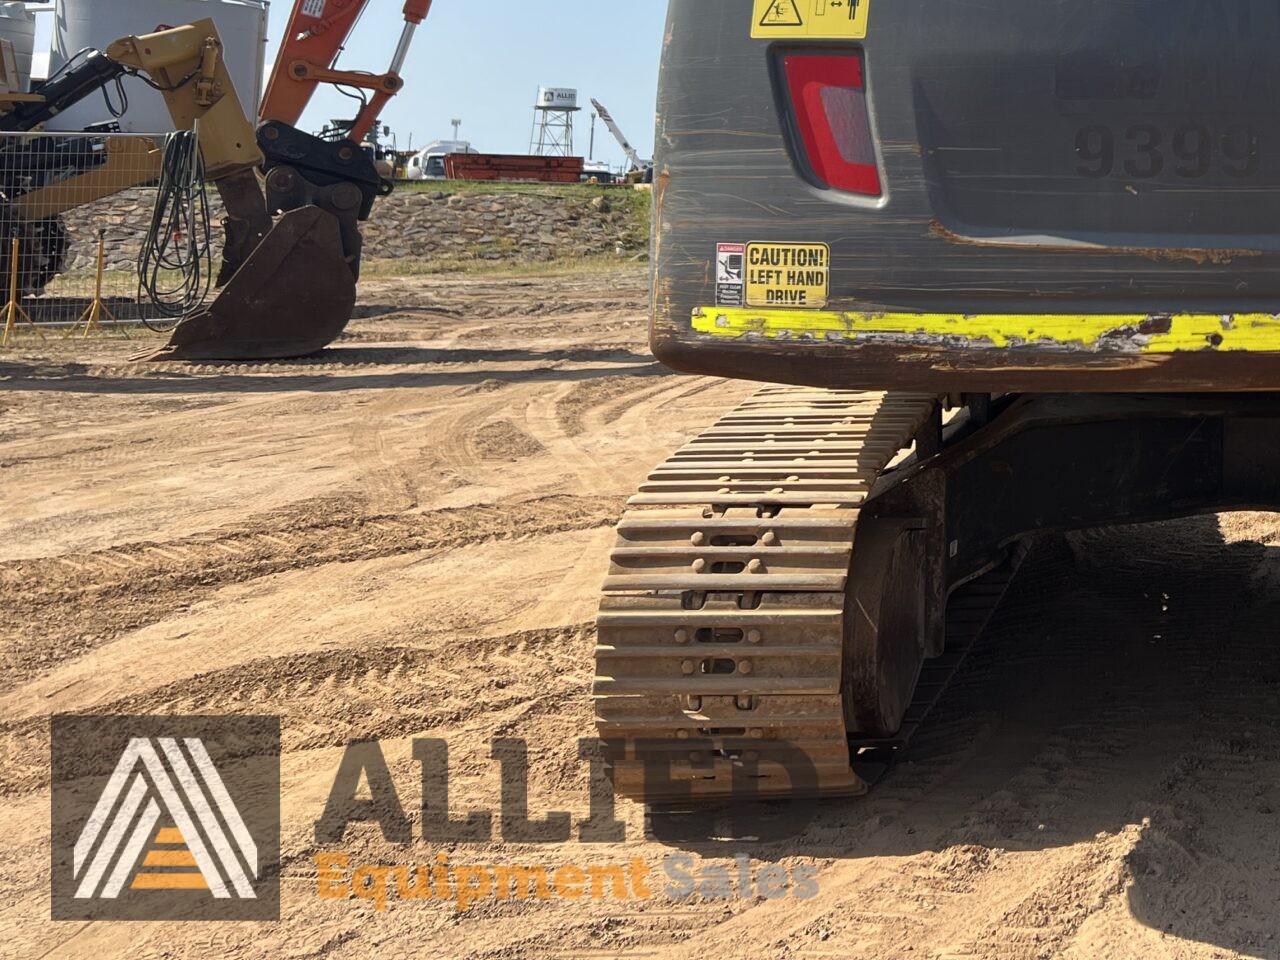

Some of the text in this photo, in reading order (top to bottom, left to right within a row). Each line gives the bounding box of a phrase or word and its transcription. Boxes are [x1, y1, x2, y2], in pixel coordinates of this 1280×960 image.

[1075, 123, 1261, 179] 9399
[750, 247, 824, 266] CAUTION!
[749, 269, 824, 286] LEFT HAND
[766, 289, 807, 305] DRIVE
